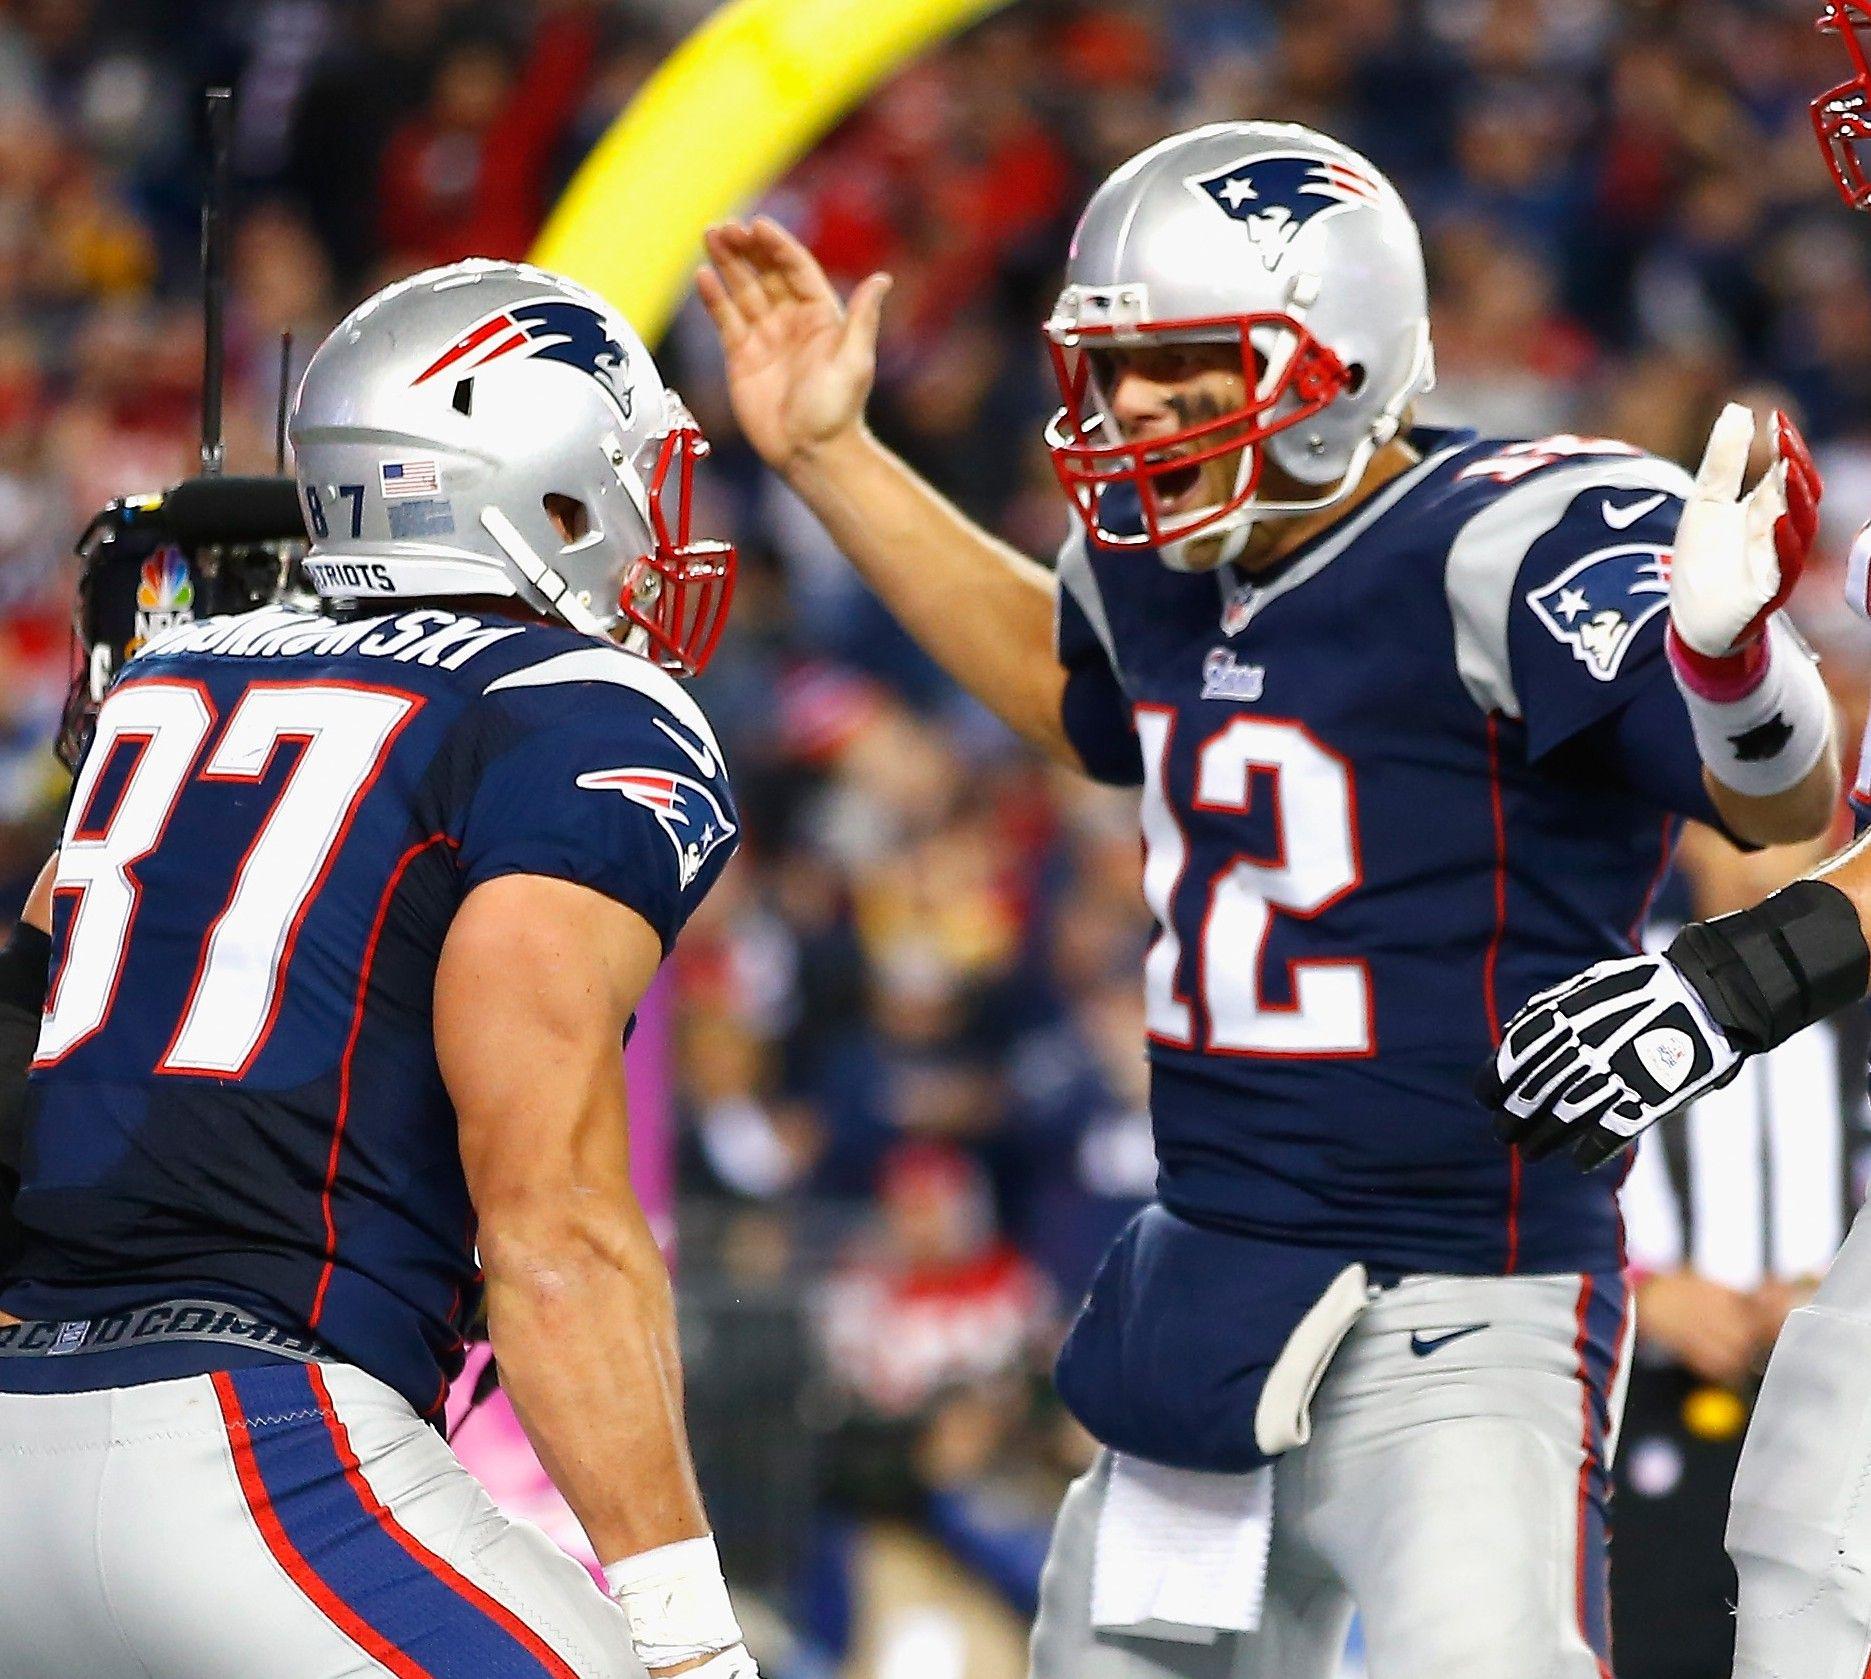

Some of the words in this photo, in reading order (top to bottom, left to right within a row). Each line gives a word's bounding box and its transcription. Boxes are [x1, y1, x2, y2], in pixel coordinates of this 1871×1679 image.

[306, 484, 365, 539] 87
[27, 676, 428, 1079] 87
[1133, 702, 1379, 1061] 12
